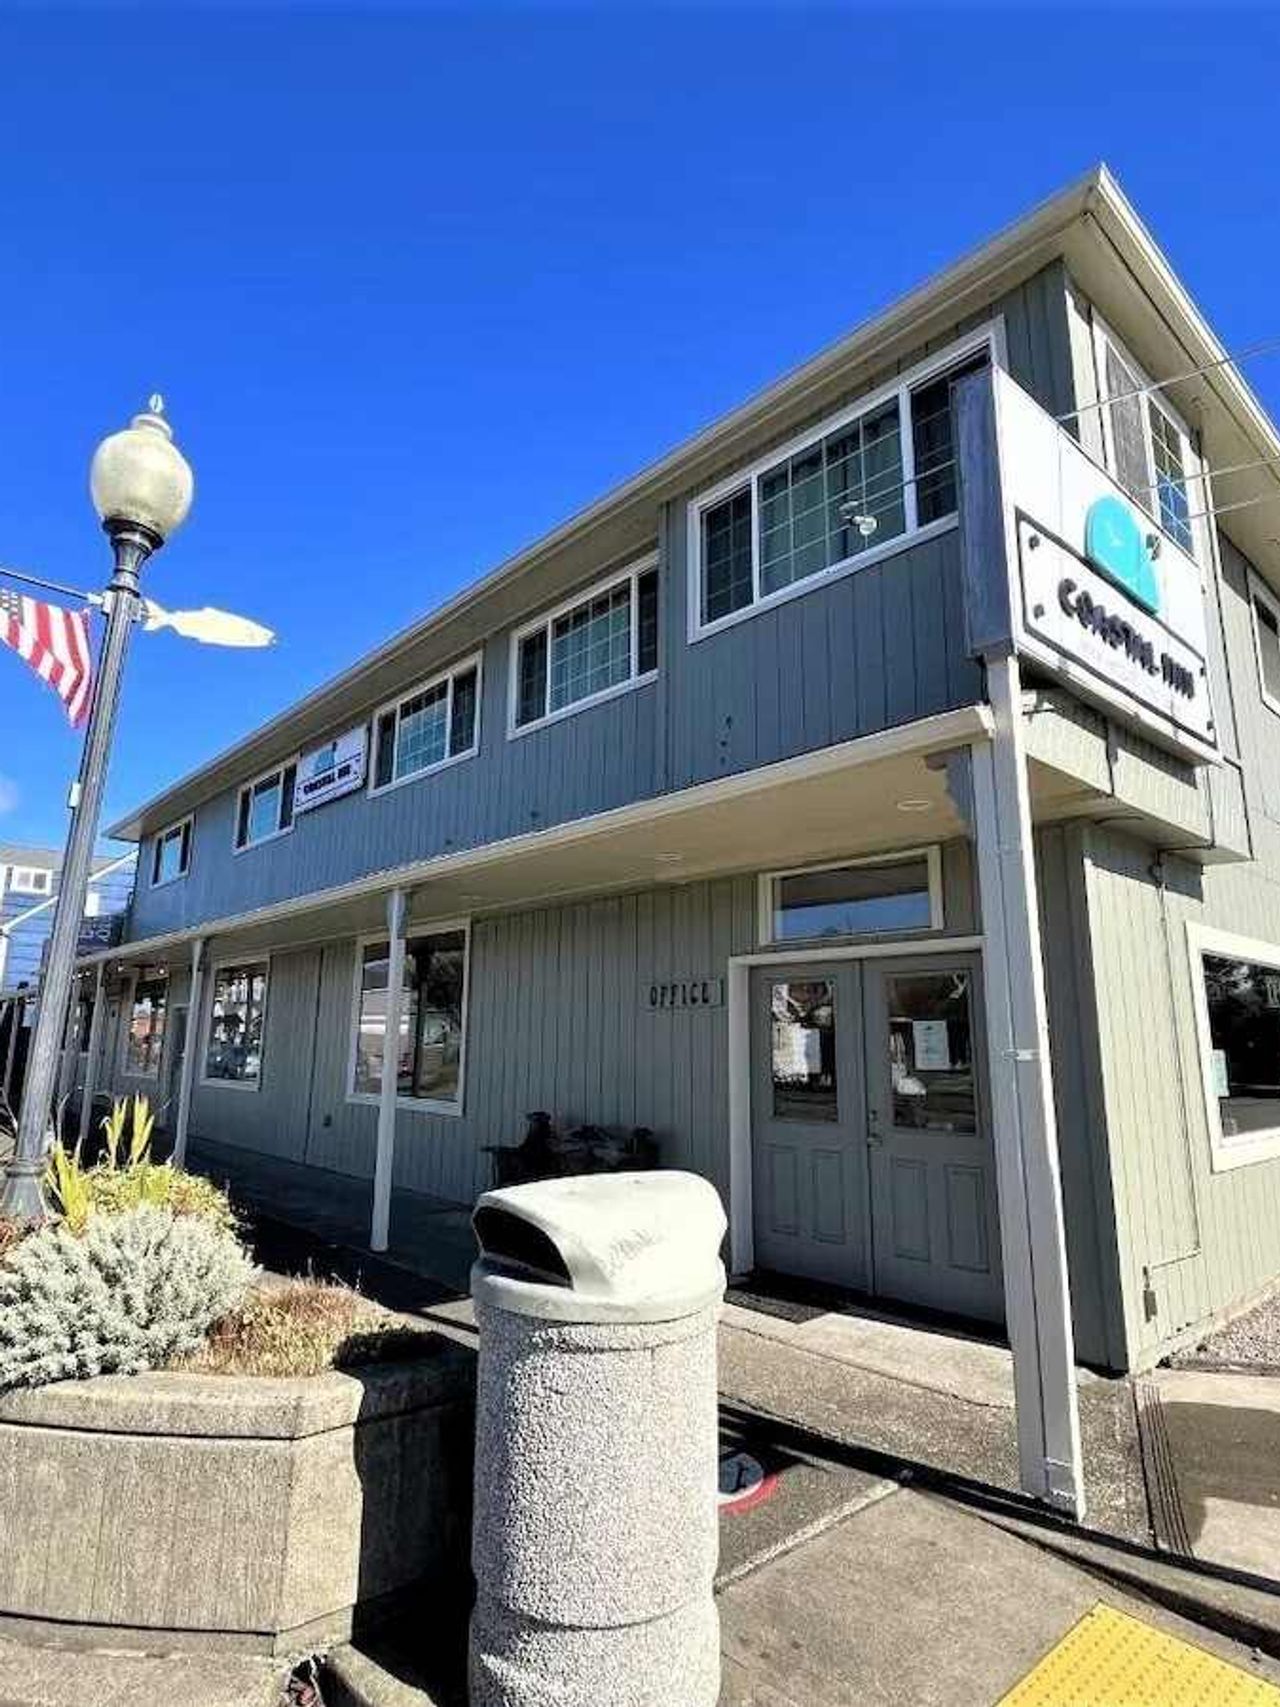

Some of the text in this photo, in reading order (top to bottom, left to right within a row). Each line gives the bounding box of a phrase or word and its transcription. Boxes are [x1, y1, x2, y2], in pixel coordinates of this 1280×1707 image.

[1058, 578, 1194, 699] COASTAL INN
[650, 982, 709, 1006] OFFICE
